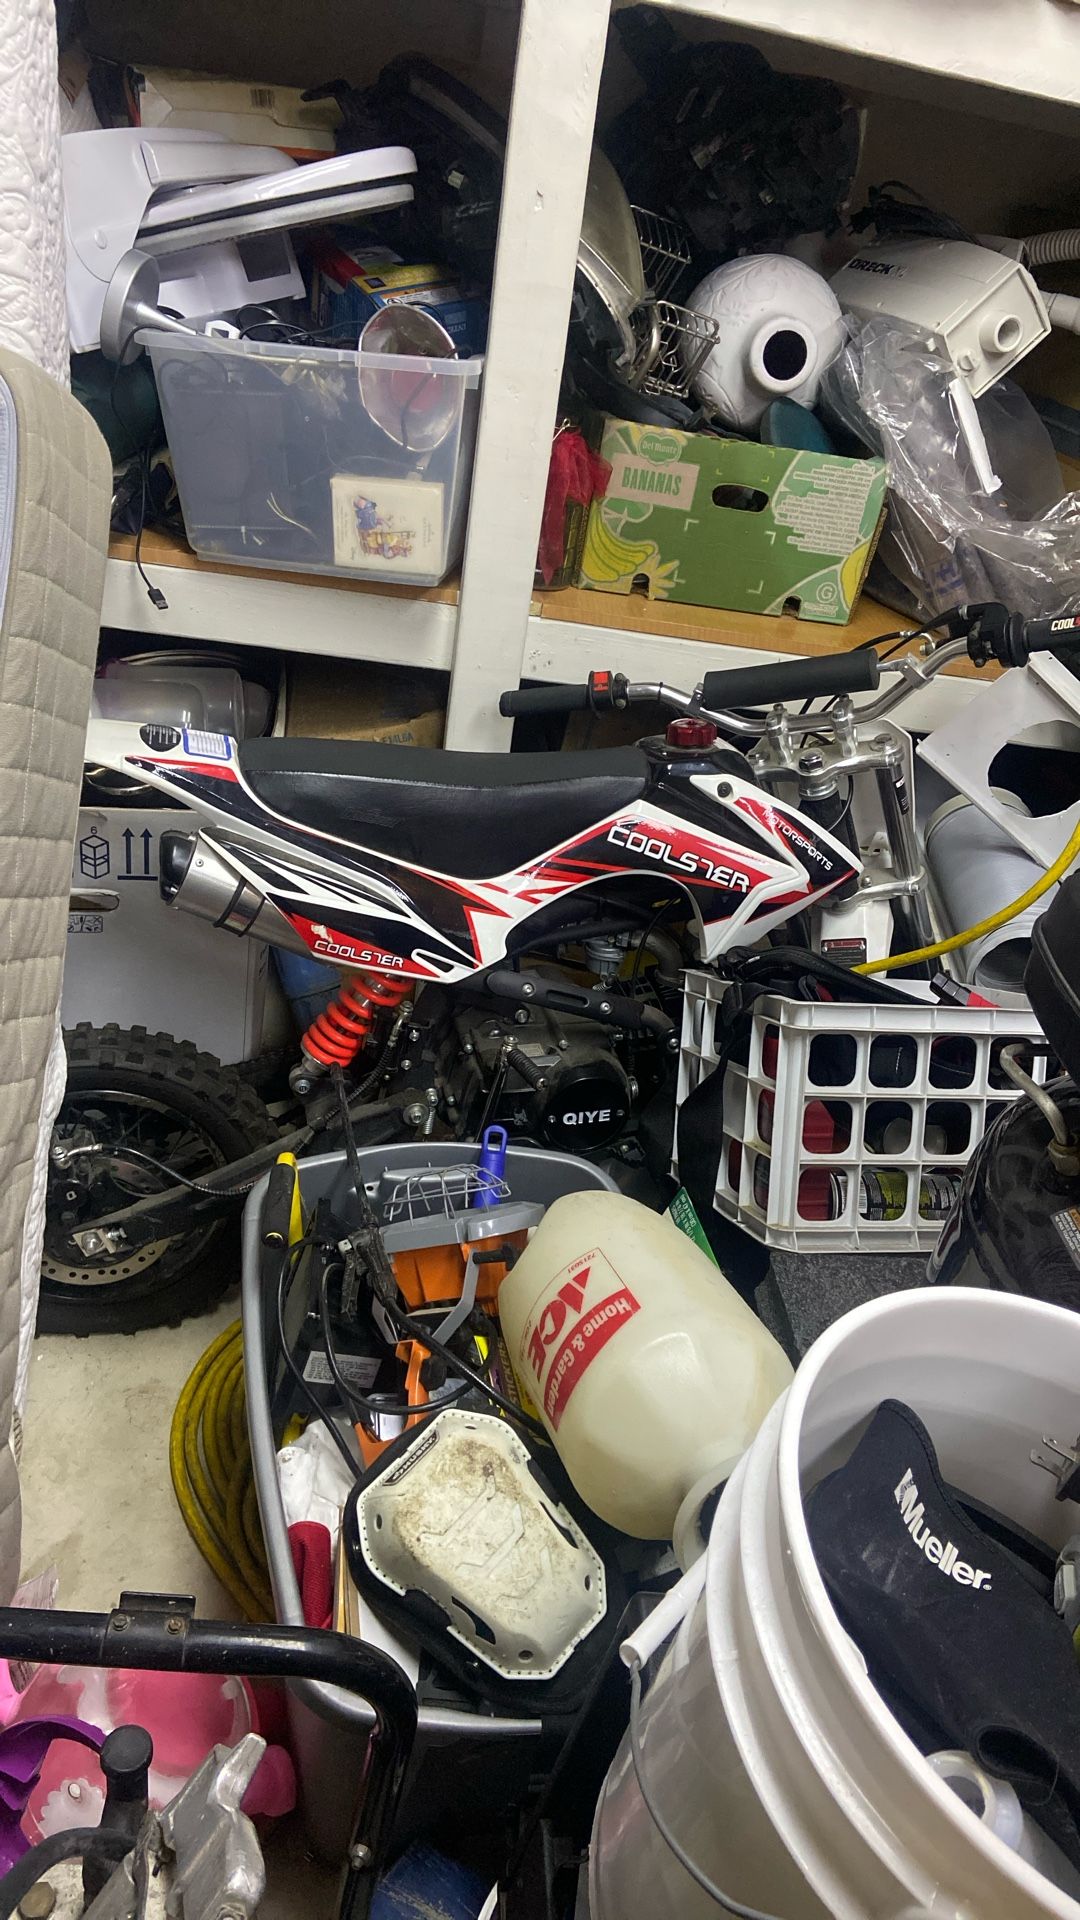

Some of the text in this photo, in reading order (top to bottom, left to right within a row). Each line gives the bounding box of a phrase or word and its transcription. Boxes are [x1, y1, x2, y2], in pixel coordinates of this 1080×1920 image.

[642, 440, 678, 454] Del Monte
[621, 466, 682, 496] BANANAS
[606, 827, 750, 894] COOLSTER
[762, 808, 833, 872] MOTORSPORTS
[314, 940, 404, 968] COOLSTER
[562, 1109, 611, 1126] QIYE
[527, 1266, 591, 1384] ACE
[546, 1297, 632, 1417] Home & Garden
[900, 1484, 992, 1590] Mueller
